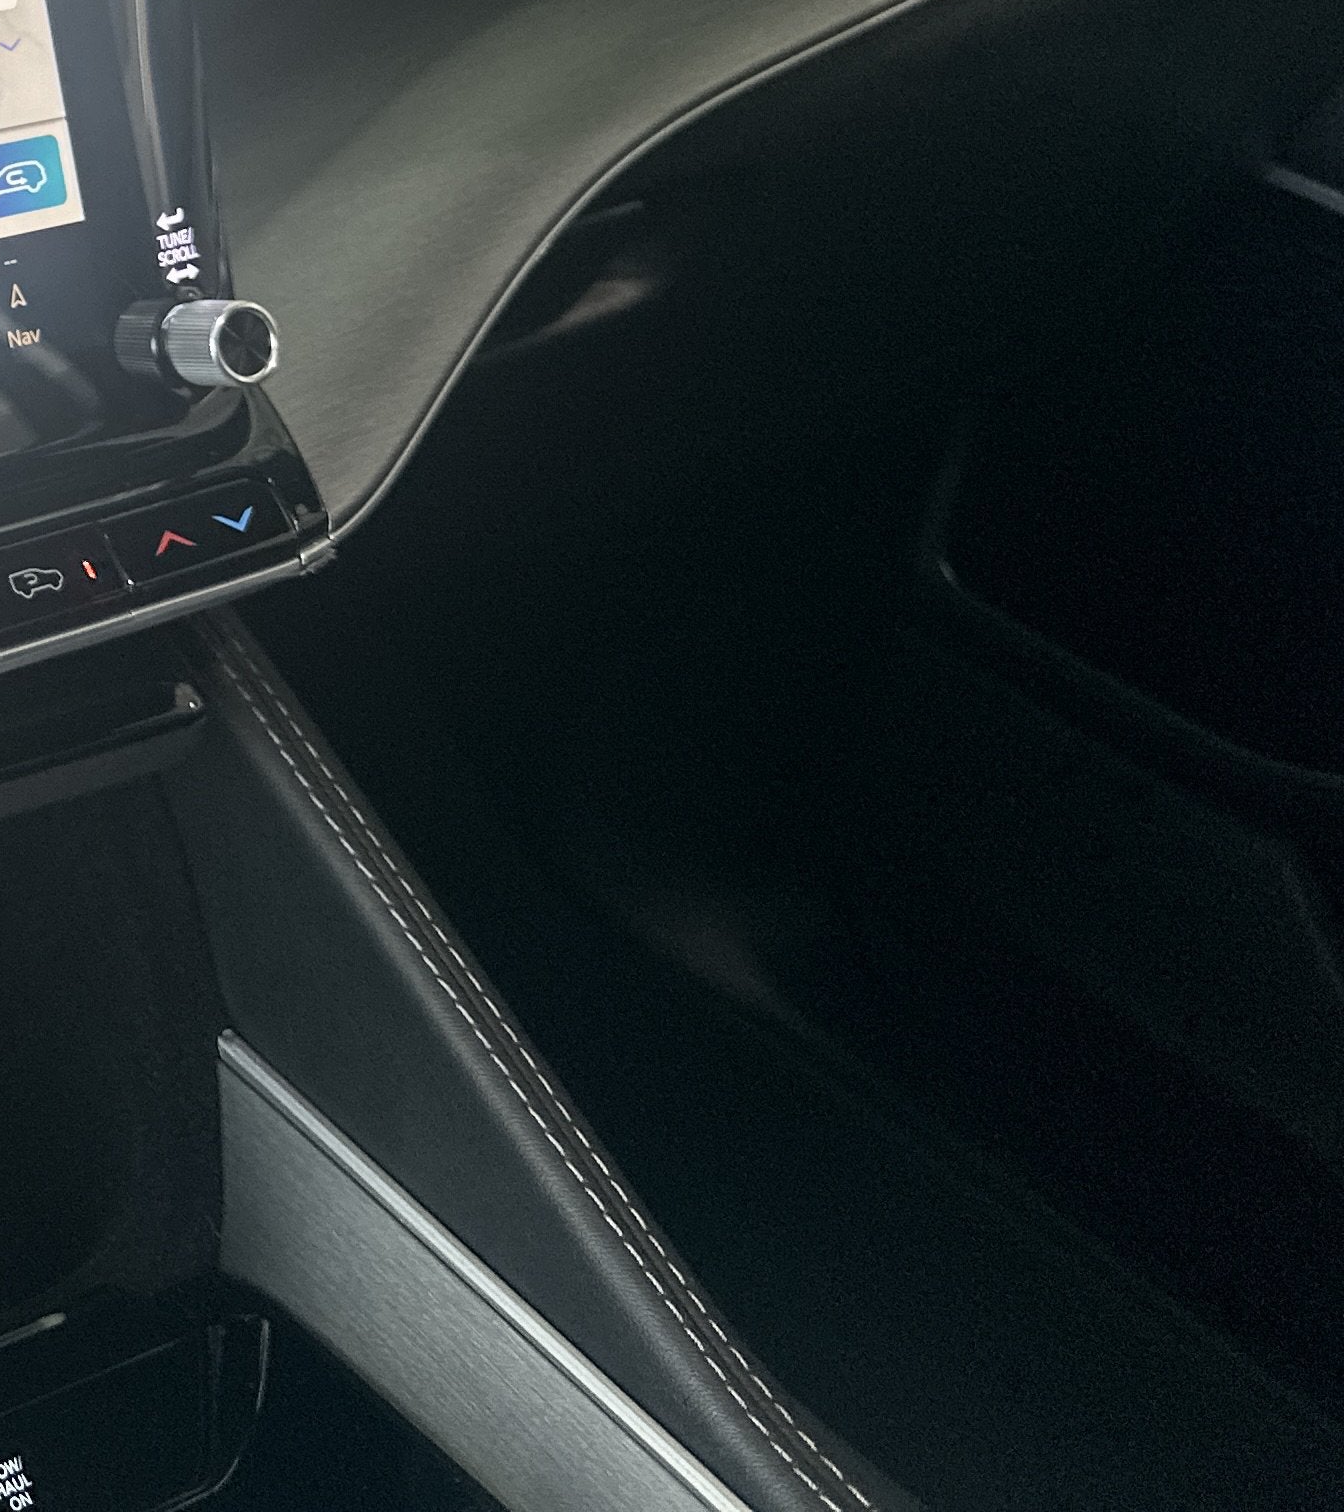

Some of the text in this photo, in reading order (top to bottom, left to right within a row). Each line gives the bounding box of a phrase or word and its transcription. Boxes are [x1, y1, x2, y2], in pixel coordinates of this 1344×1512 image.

[157, 243, 202, 267] SCROLL
[7, 325, 41, 349] Nav
[9, 1491, 33, 1511] ON
